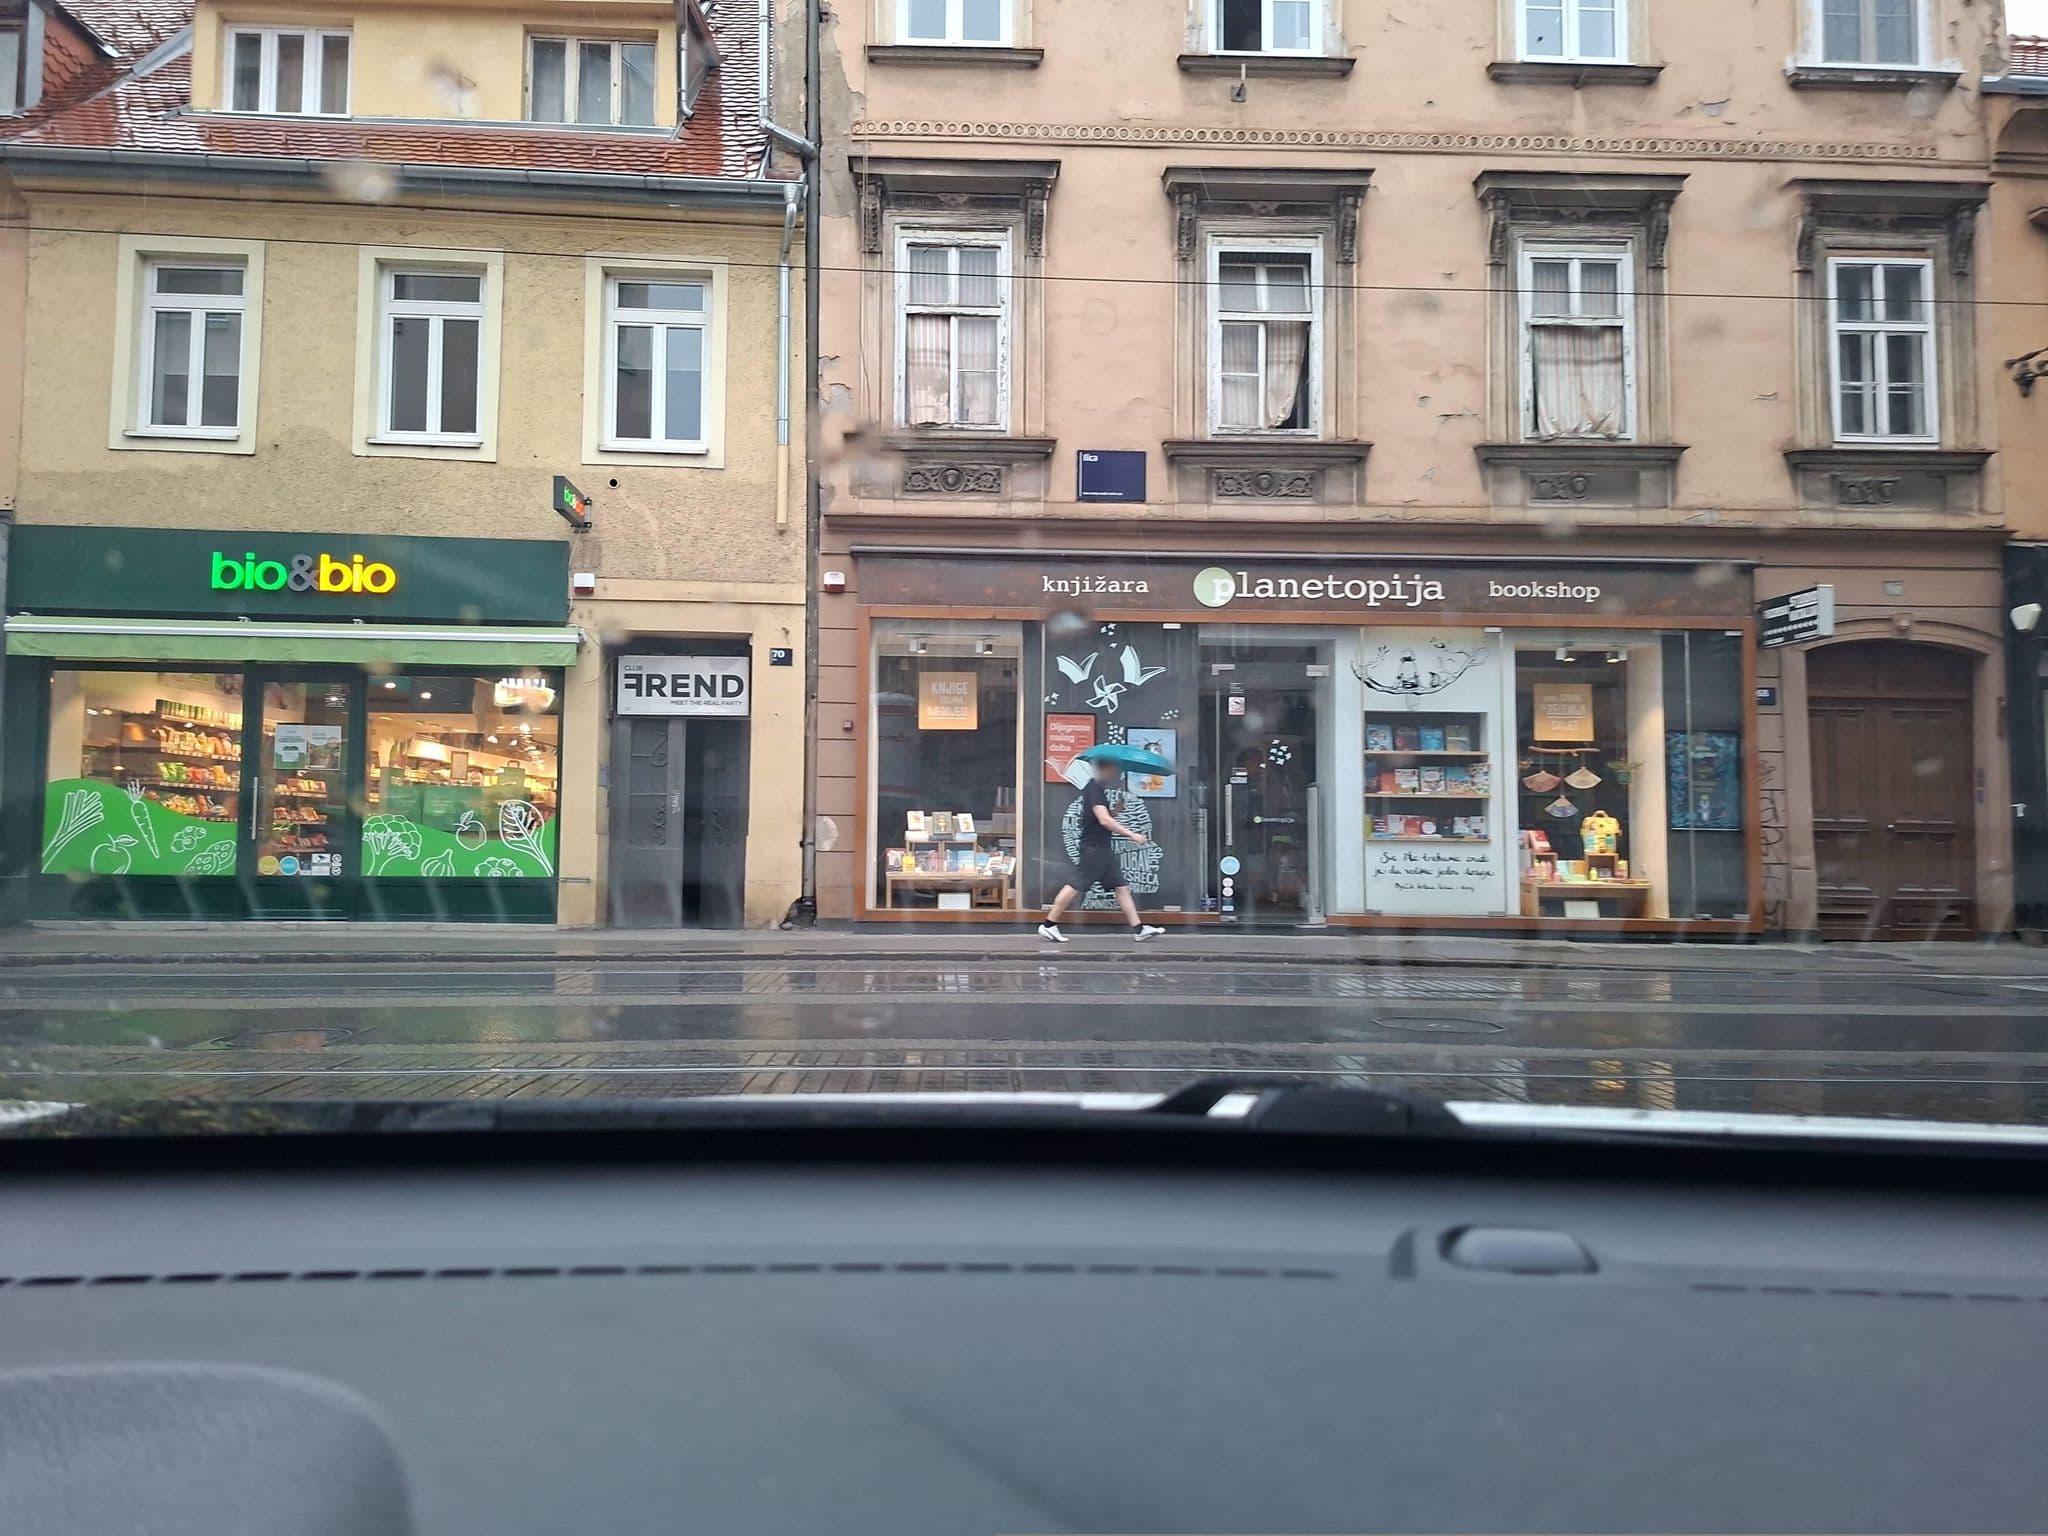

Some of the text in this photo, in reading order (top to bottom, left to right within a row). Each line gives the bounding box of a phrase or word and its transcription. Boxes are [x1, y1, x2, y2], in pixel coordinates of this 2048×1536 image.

[211, 551, 397, 594] bio&bio
[1041, 575, 1150, 597] knjižara
[1211, 570, 1447, 608] planetopija
[1488, 580, 1601, 603] bookshop
[771, 650, 786, 659] 70
[1049, 743, 1072, 752] doba
